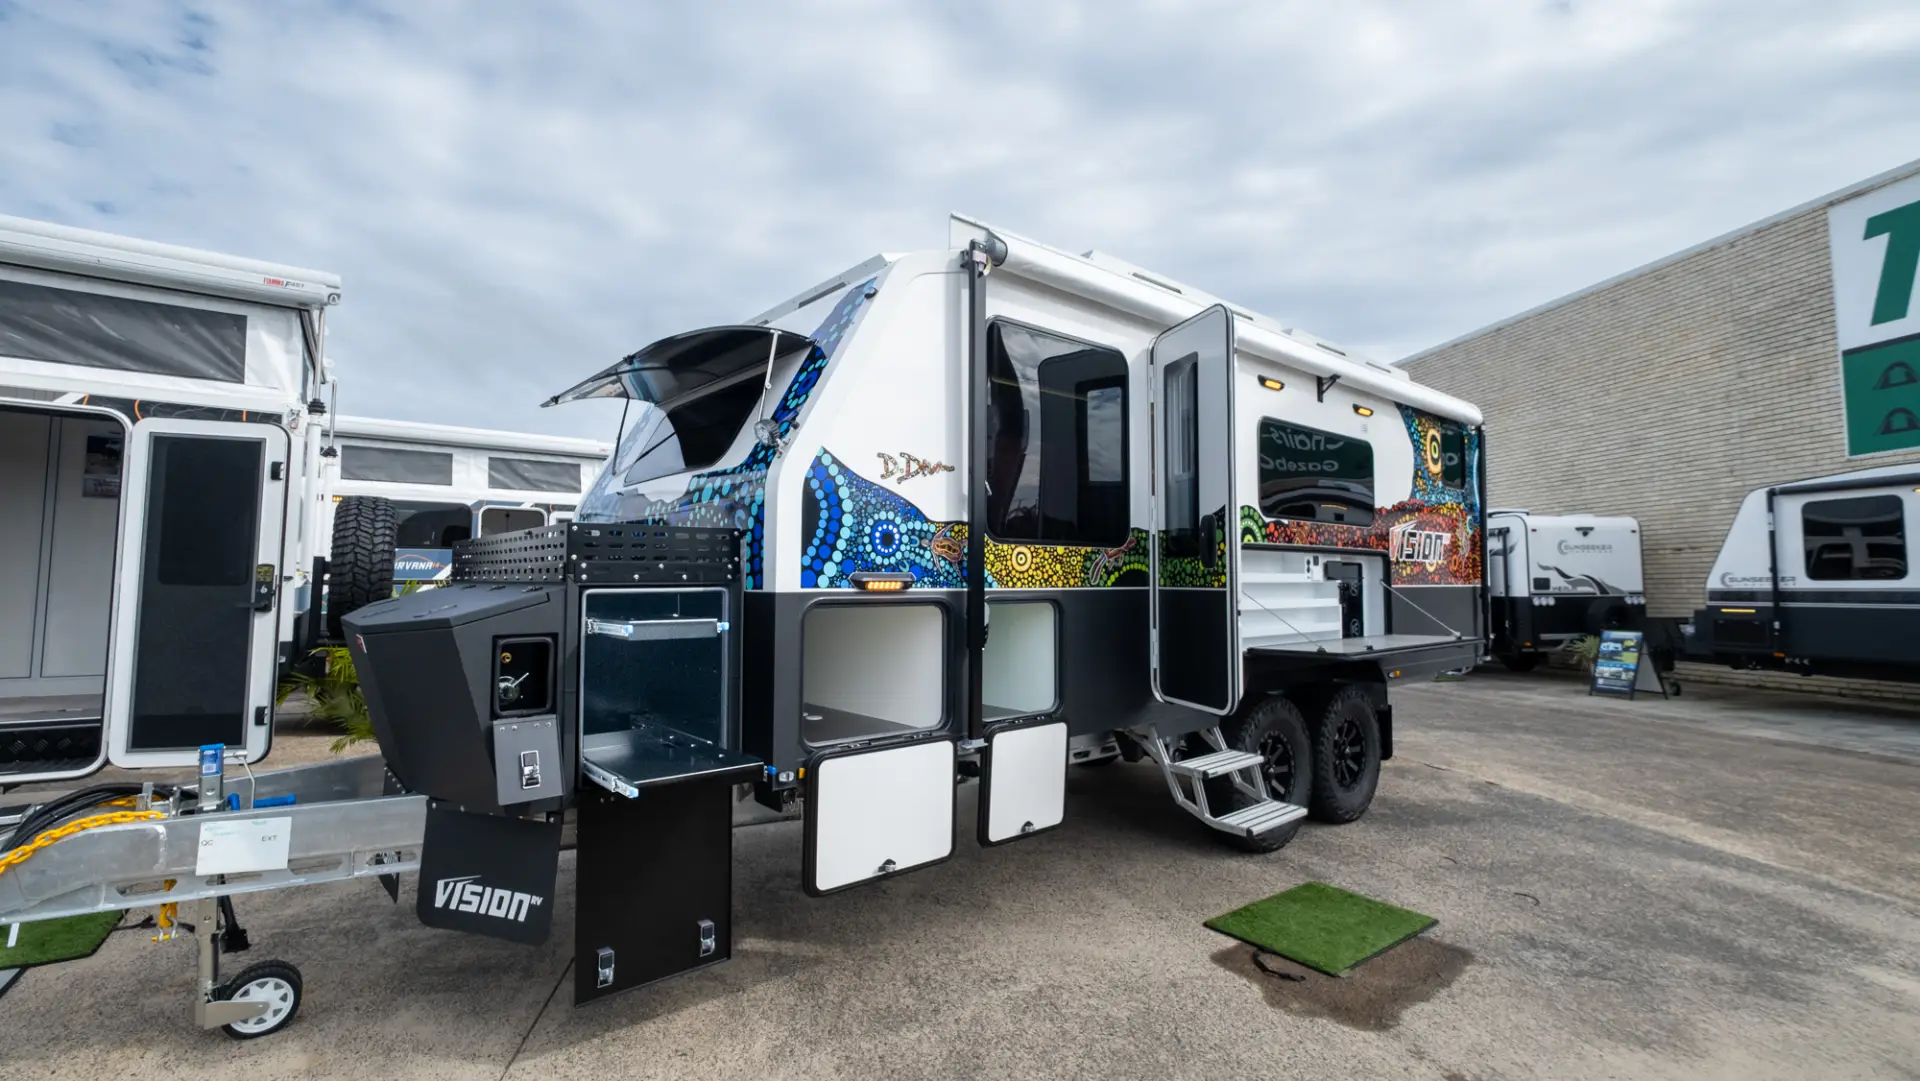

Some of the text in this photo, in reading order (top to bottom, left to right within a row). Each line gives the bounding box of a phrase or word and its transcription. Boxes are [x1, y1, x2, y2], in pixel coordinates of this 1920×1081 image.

[394, 560, 433, 571] IRVANA
[261, 834, 279, 842] EXT
[434, 874, 532, 922] VISION
